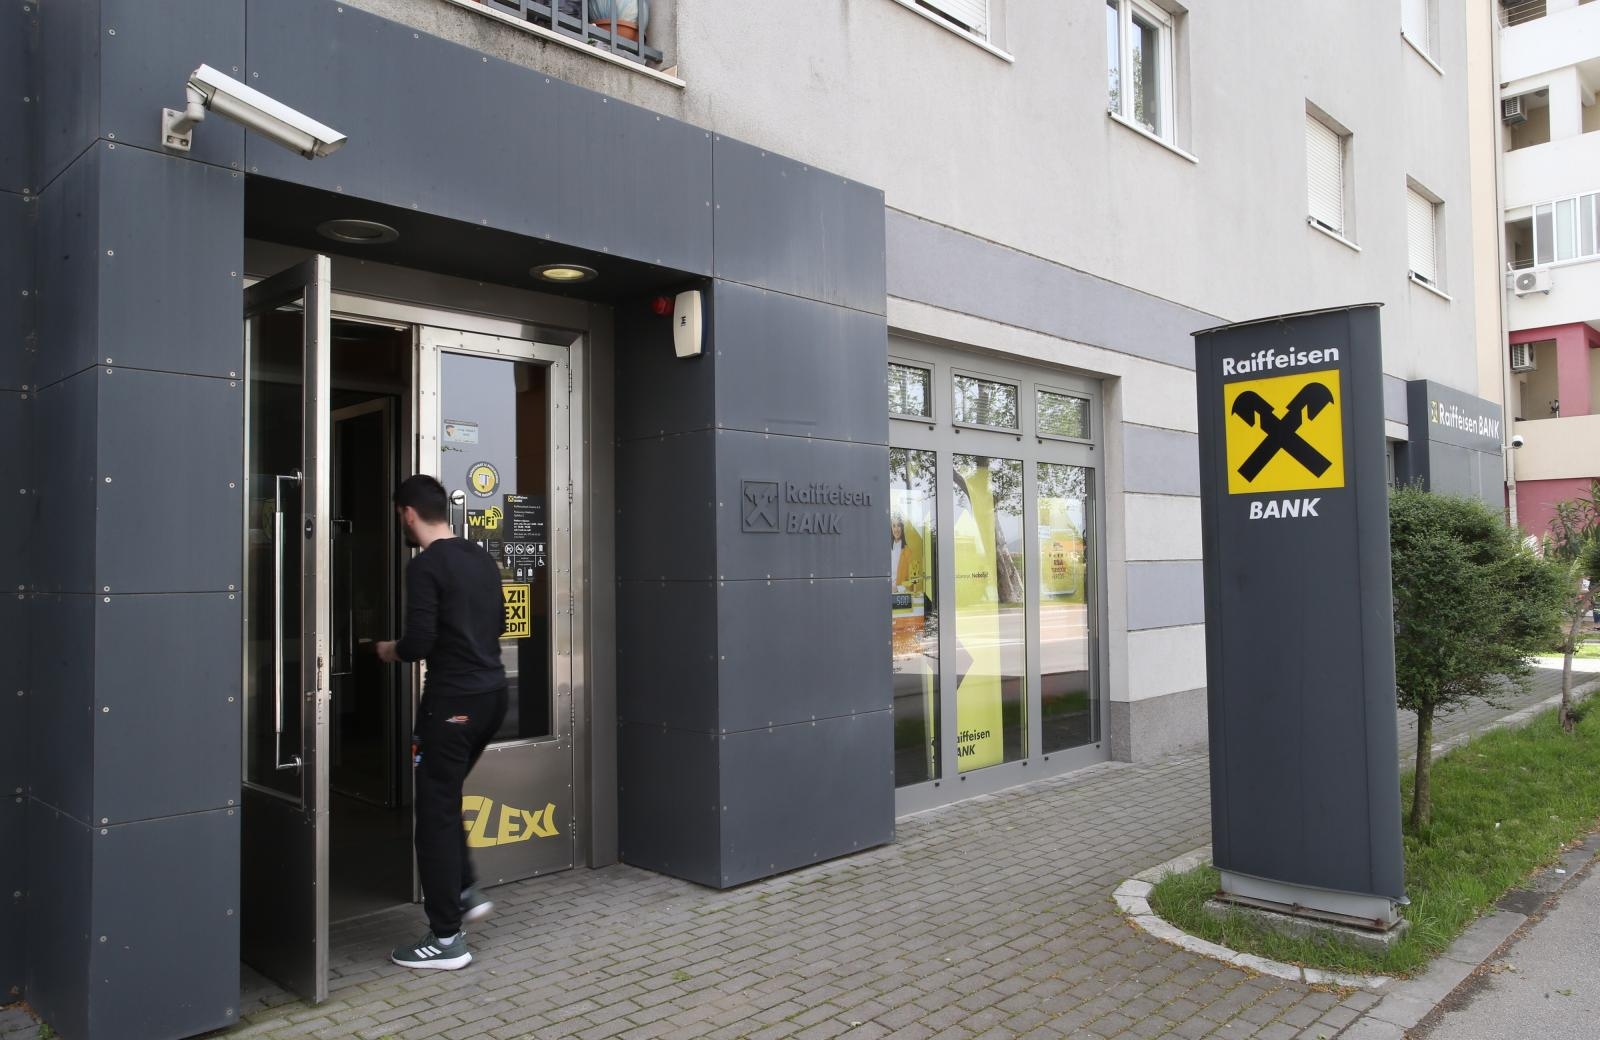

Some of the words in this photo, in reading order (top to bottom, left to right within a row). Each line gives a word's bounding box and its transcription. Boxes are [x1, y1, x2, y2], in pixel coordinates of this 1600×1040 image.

[1222, 347, 1340, 376] Raiffeisen
[1439, 403, 1478, 435] Raiffeisen
[1478, 415, 1500, 439] BANK
[785, 480, 873, 507] Raiffeisen
[1249, 497, 1321, 519] BANK
[468, 515, 495, 527] WiFi
[786, 512, 841, 534] BANK
[502, 590, 525, 603] ZI!
[504, 605, 525, 619] EXI
[505, 622, 527, 633] EDIT
[957, 744, 976, 758] ANK
